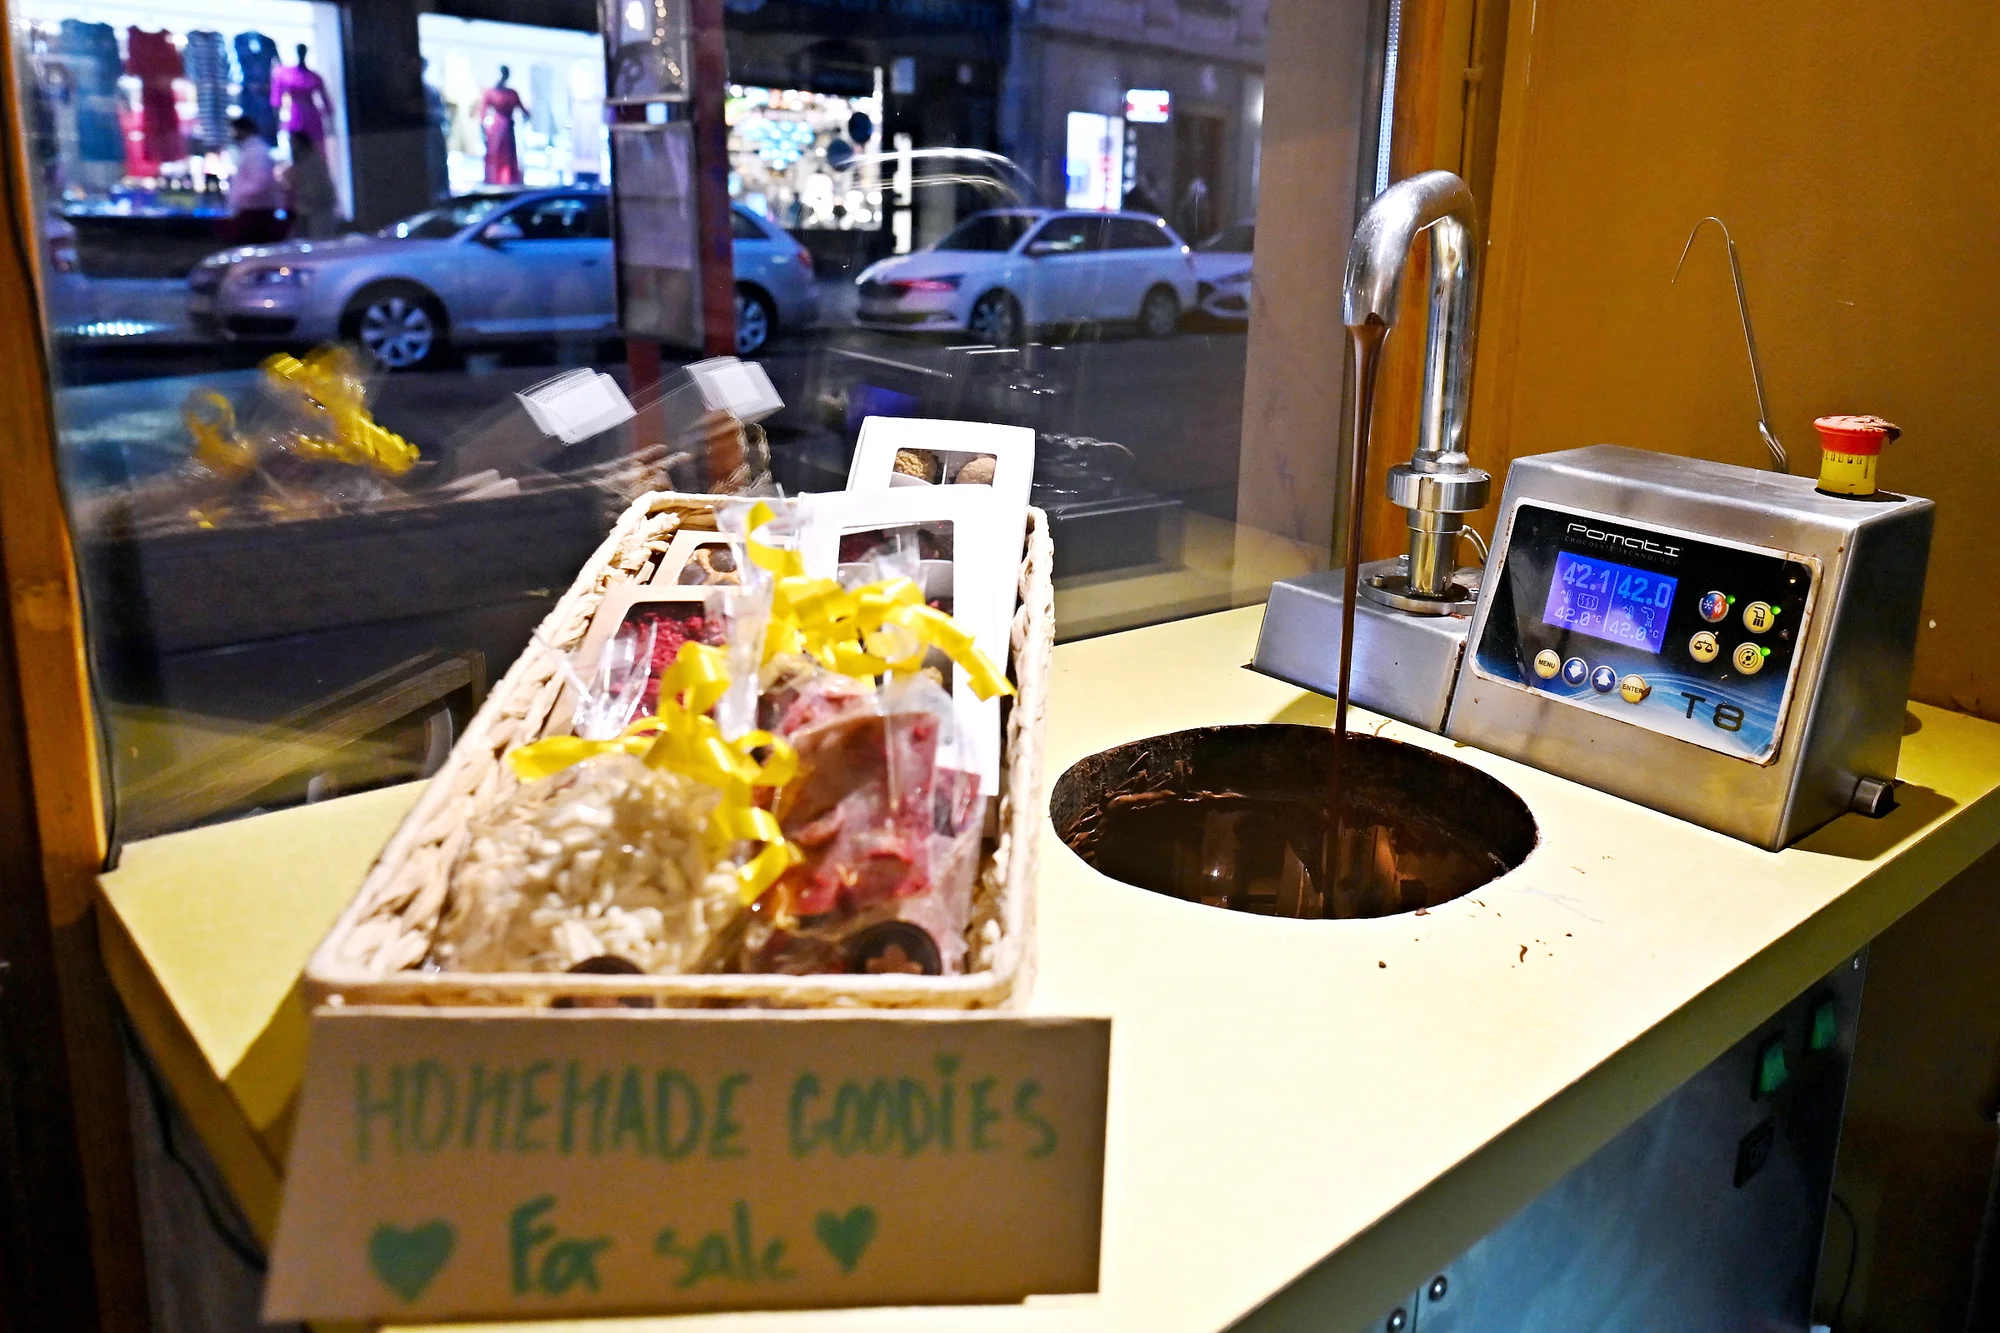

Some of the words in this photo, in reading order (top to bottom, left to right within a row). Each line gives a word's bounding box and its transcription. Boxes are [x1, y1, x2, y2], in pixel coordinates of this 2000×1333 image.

[1563, 561, 1610, 593] 42.1
[1618, 575, 1672, 609] 42.0
[1538, 659, 1556, 669] MENU
[1622, 683, 1644, 694] ENTER
[1681, 692, 1744, 732] T8
[355, 1058, 750, 1165] HOMEMADE
[509, 1194, 614, 1297] For
[653, 1199, 797, 1291] sale
